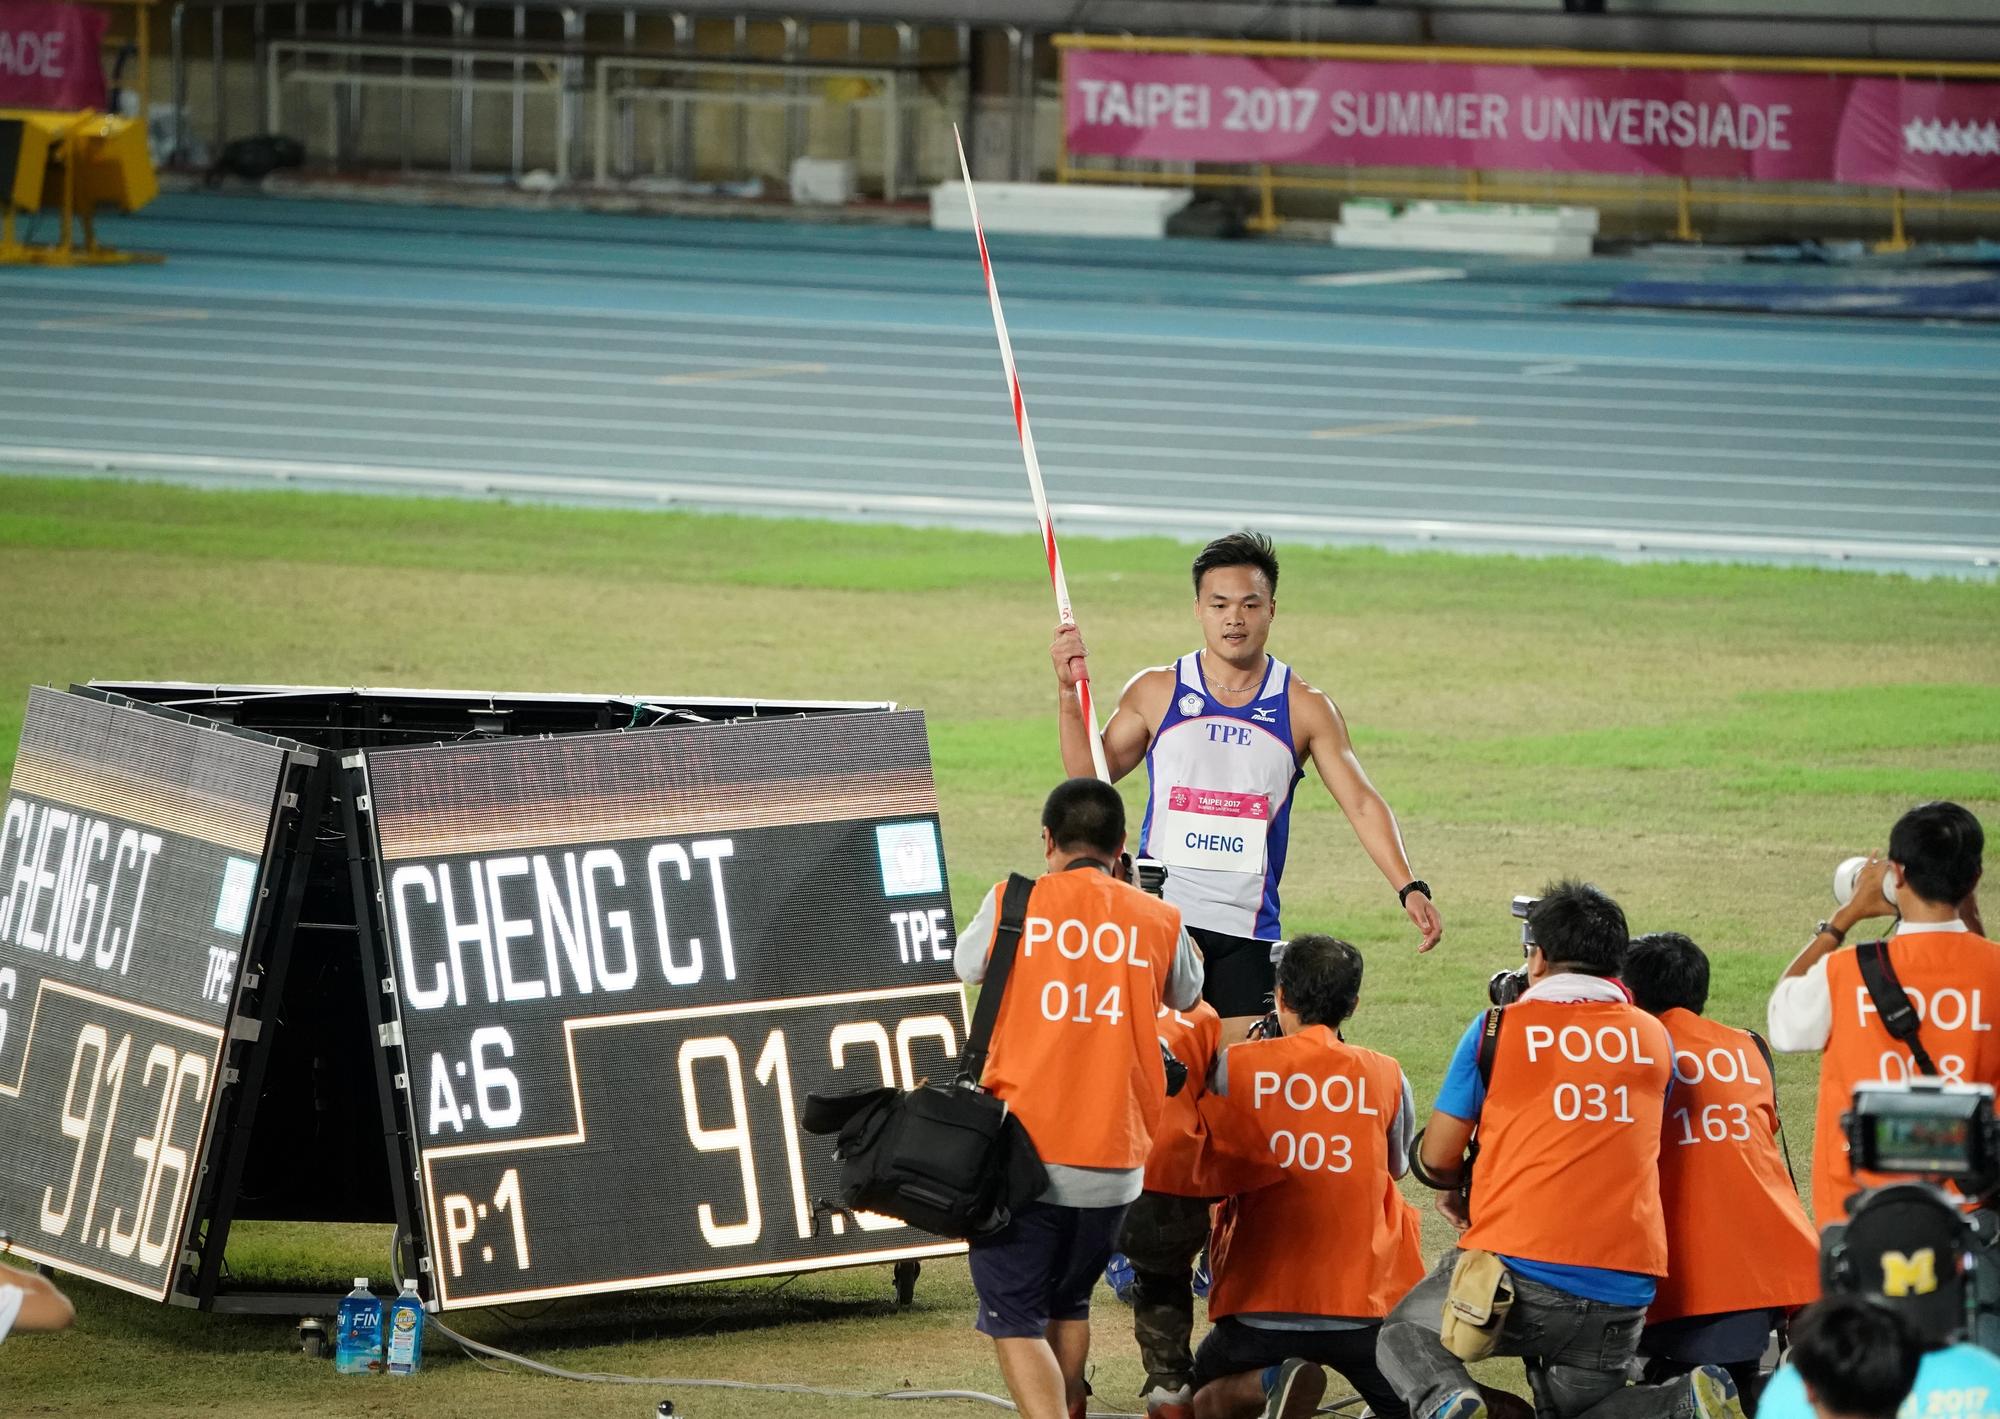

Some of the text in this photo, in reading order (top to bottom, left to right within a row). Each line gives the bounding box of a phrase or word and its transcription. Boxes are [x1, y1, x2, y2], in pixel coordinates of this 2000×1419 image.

[1077, 79, 1791, 151] TAIPEI 2017 SUMMER UNIVERSIADE
[1205, 723, 1252, 746] TPE
[1198, 797, 1241, 808] TAIPEI 2017
[1185, 832, 1244, 853] CHENG
[0, 798, 162, 975] CHENG CT
[391, 838, 736, 1010] CHENG CT
[889, 909, 952, 963] TPE
[1024, 917, 1149, 968] POOL
[202, 945, 237, 1004] TPE
[1041, 980, 1124, 1025] 014
[1525, 1025, 1654, 1065] POOL
[428, 1026, 521, 1135] A:6
[1254, 1071, 1379, 1117] POOL
[1553, 1082, 1635, 1124] 031
[40, 1024, 207, 1267] 91.36
[1673, 1103, 1751, 1145] 163
[1270, 1129, 1353, 1174] 003
[444, 1169, 531, 1277] P:1
[1881, 1248, 1938, 1297] M
[353, 1313, 380, 1327] FIN
